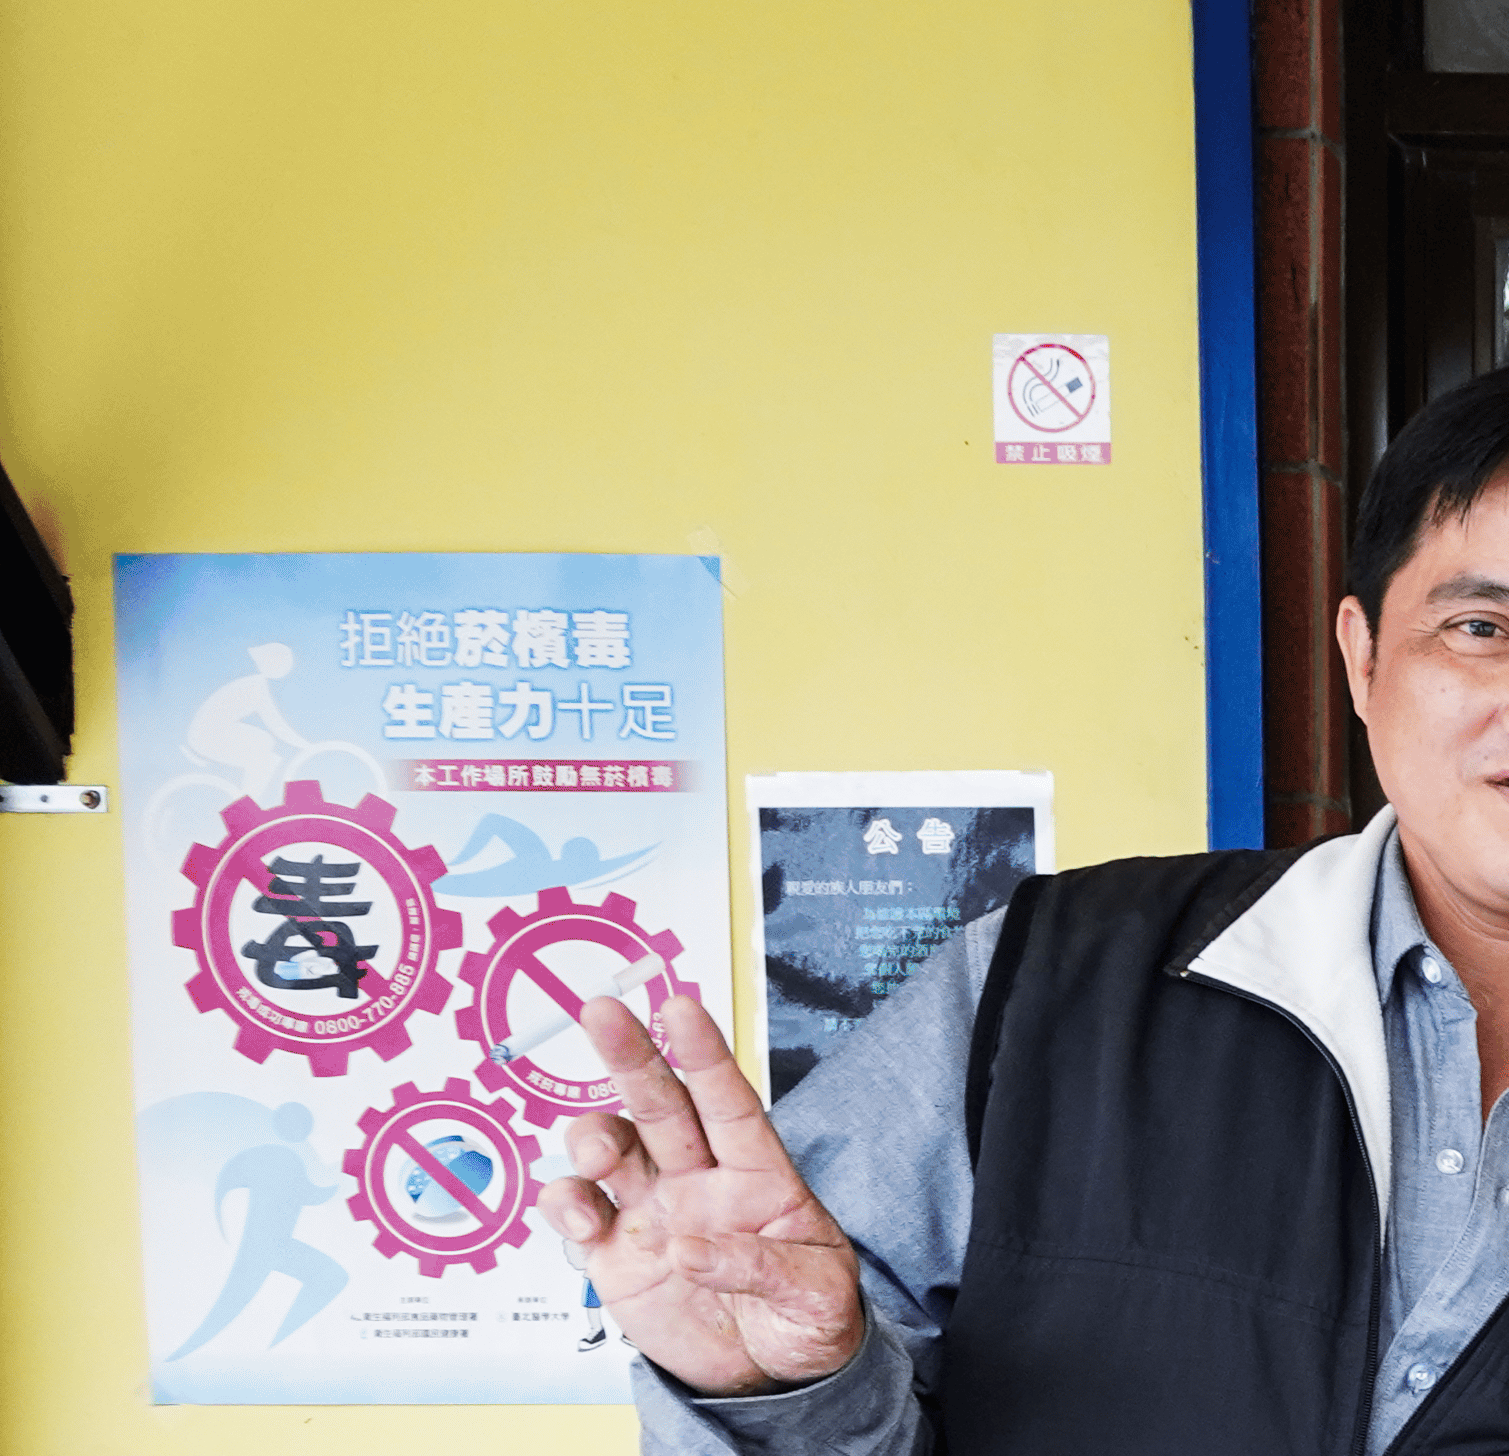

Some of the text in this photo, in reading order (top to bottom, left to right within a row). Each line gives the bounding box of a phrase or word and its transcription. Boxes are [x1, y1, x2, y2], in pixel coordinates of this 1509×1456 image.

[340, 608, 632, 669] 拒絕菸檳毒
[382, 681, 678, 741] 生產力十足
[863, 818, 955, 855] 公告
[314, 963, 414, 1035] 0800-770-885
